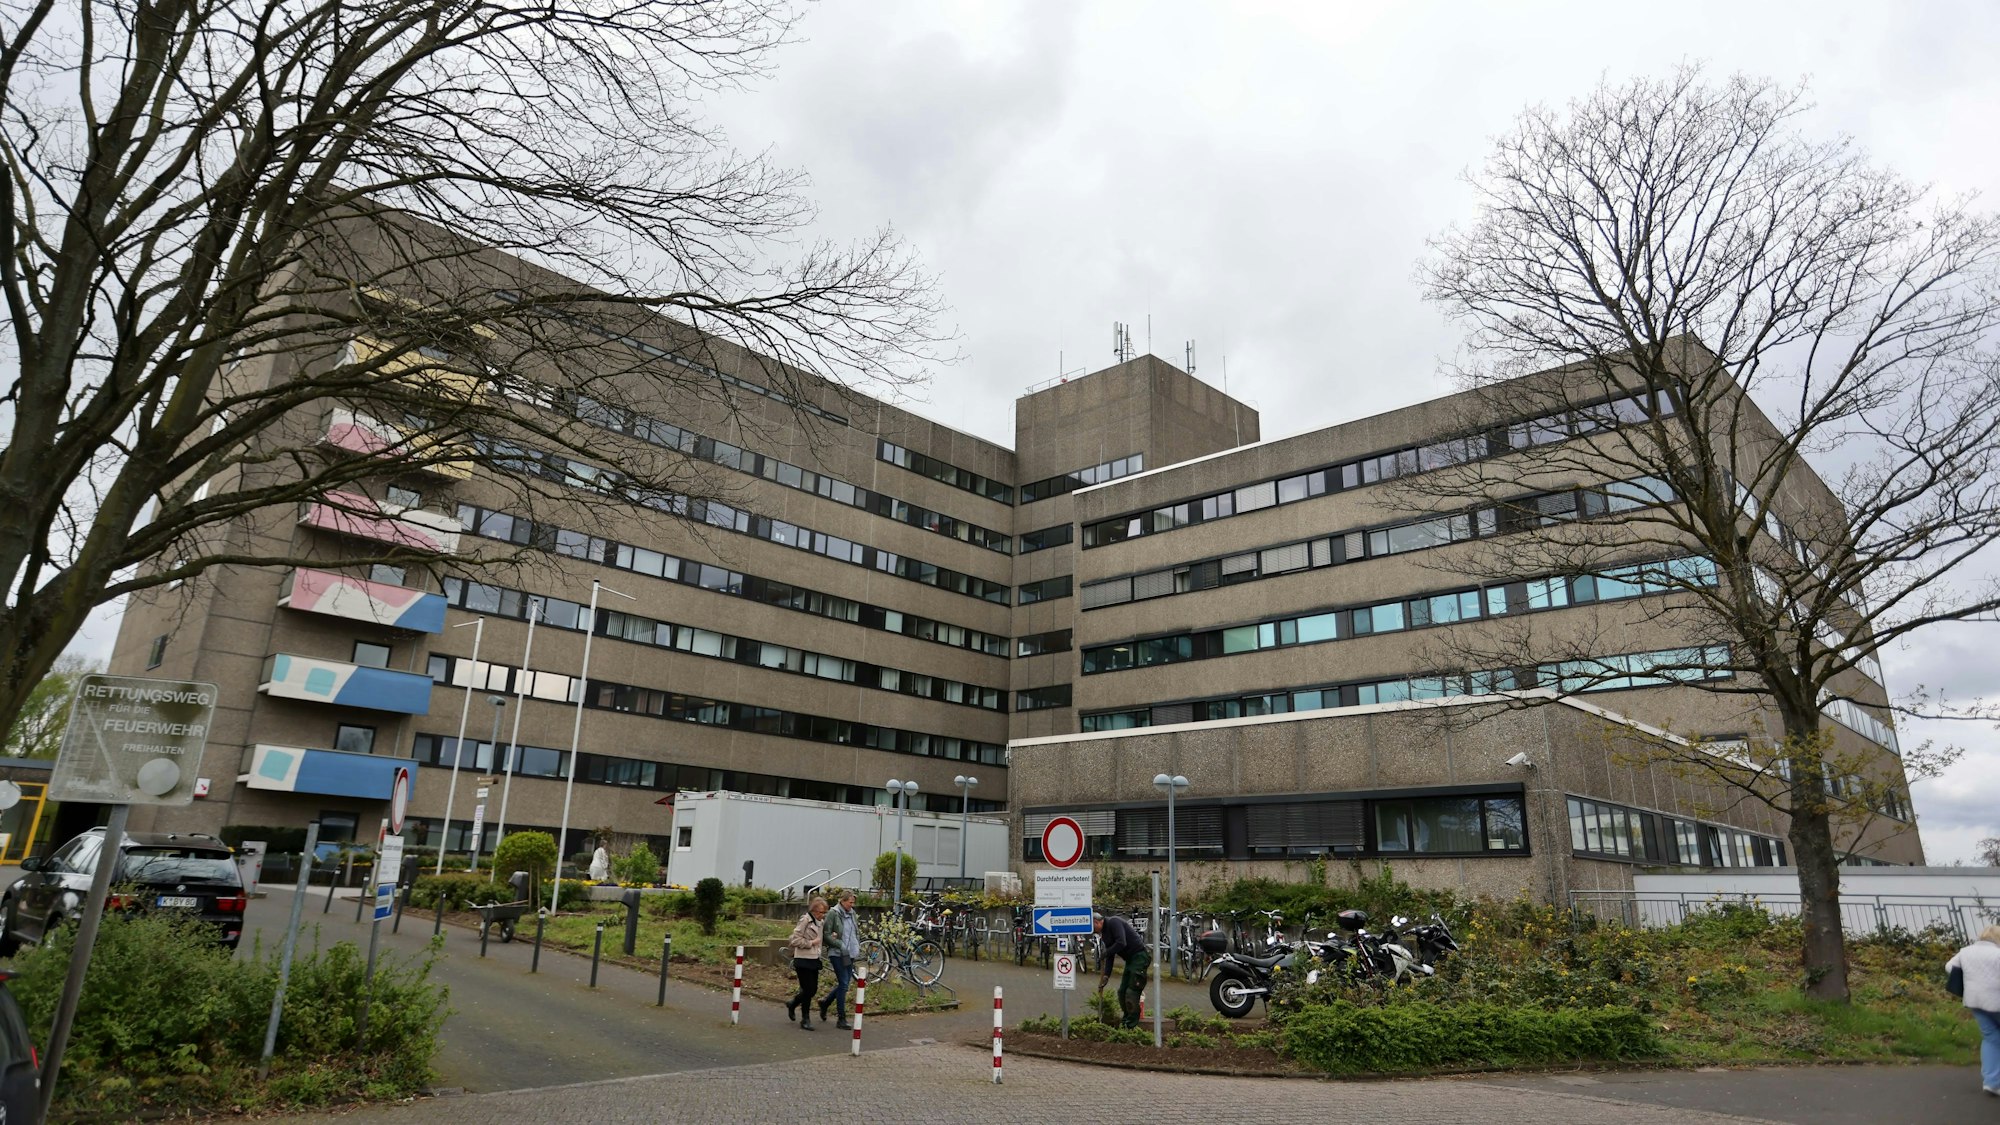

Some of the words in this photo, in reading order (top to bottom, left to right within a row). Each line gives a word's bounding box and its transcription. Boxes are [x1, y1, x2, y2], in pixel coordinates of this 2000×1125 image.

[84, 684, 209, 705] RETTUNGSWEG
[109, 704, 130, 713] FÜR
[133, 706, 152, 714] DIE
[103, 719, 206, 737] FEUERWEHR
[122, 743, 185, 755] FREIHALTEN
[1050, 916, 1089, 924] Einbahnstraße
